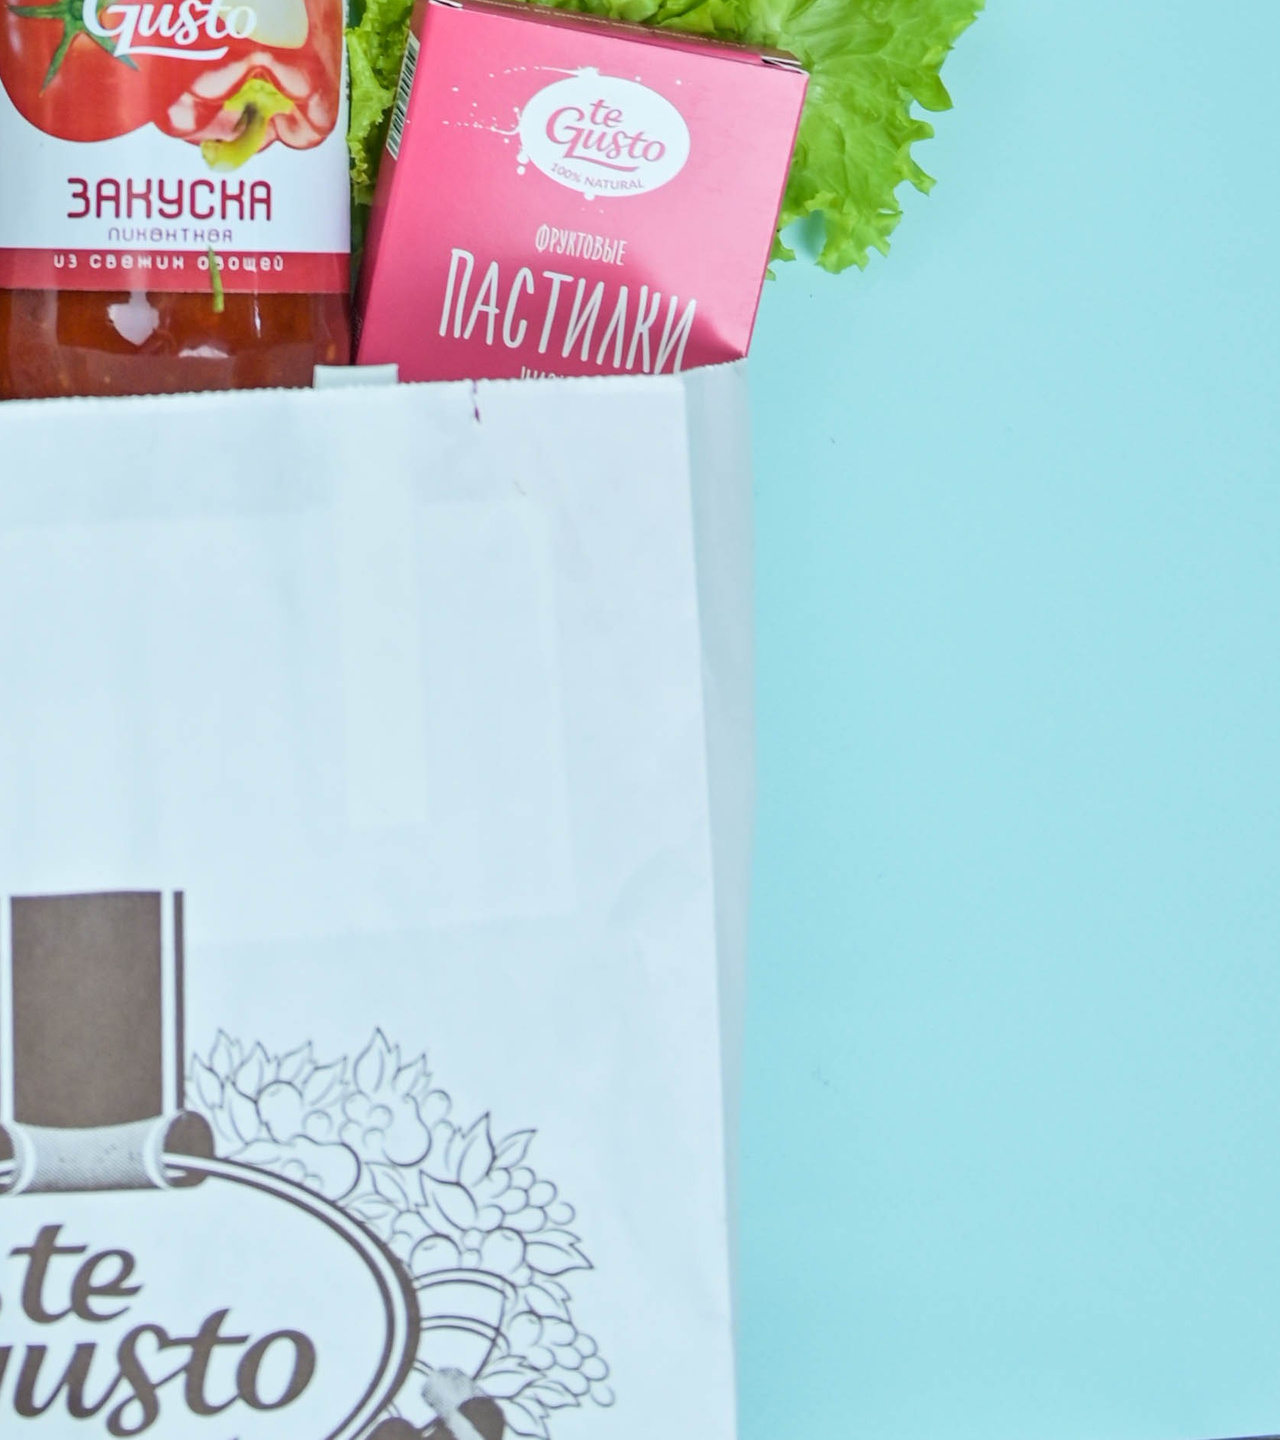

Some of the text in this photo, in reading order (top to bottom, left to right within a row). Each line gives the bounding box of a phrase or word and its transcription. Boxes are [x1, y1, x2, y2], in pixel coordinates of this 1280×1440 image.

[588, 98, 624, 128] te
[545, 106, 666, 173] Gusto
[550, 162, 645, 191] 100% NATURAL
[66, 177, 272, 222] ЗАКУСКА
[534, 223, 628, 266] ФРУКТОВЫЕ
[438, 247, 697, 375] ПАСТИЛКИ
[8, 1224, 142, 1324] te
